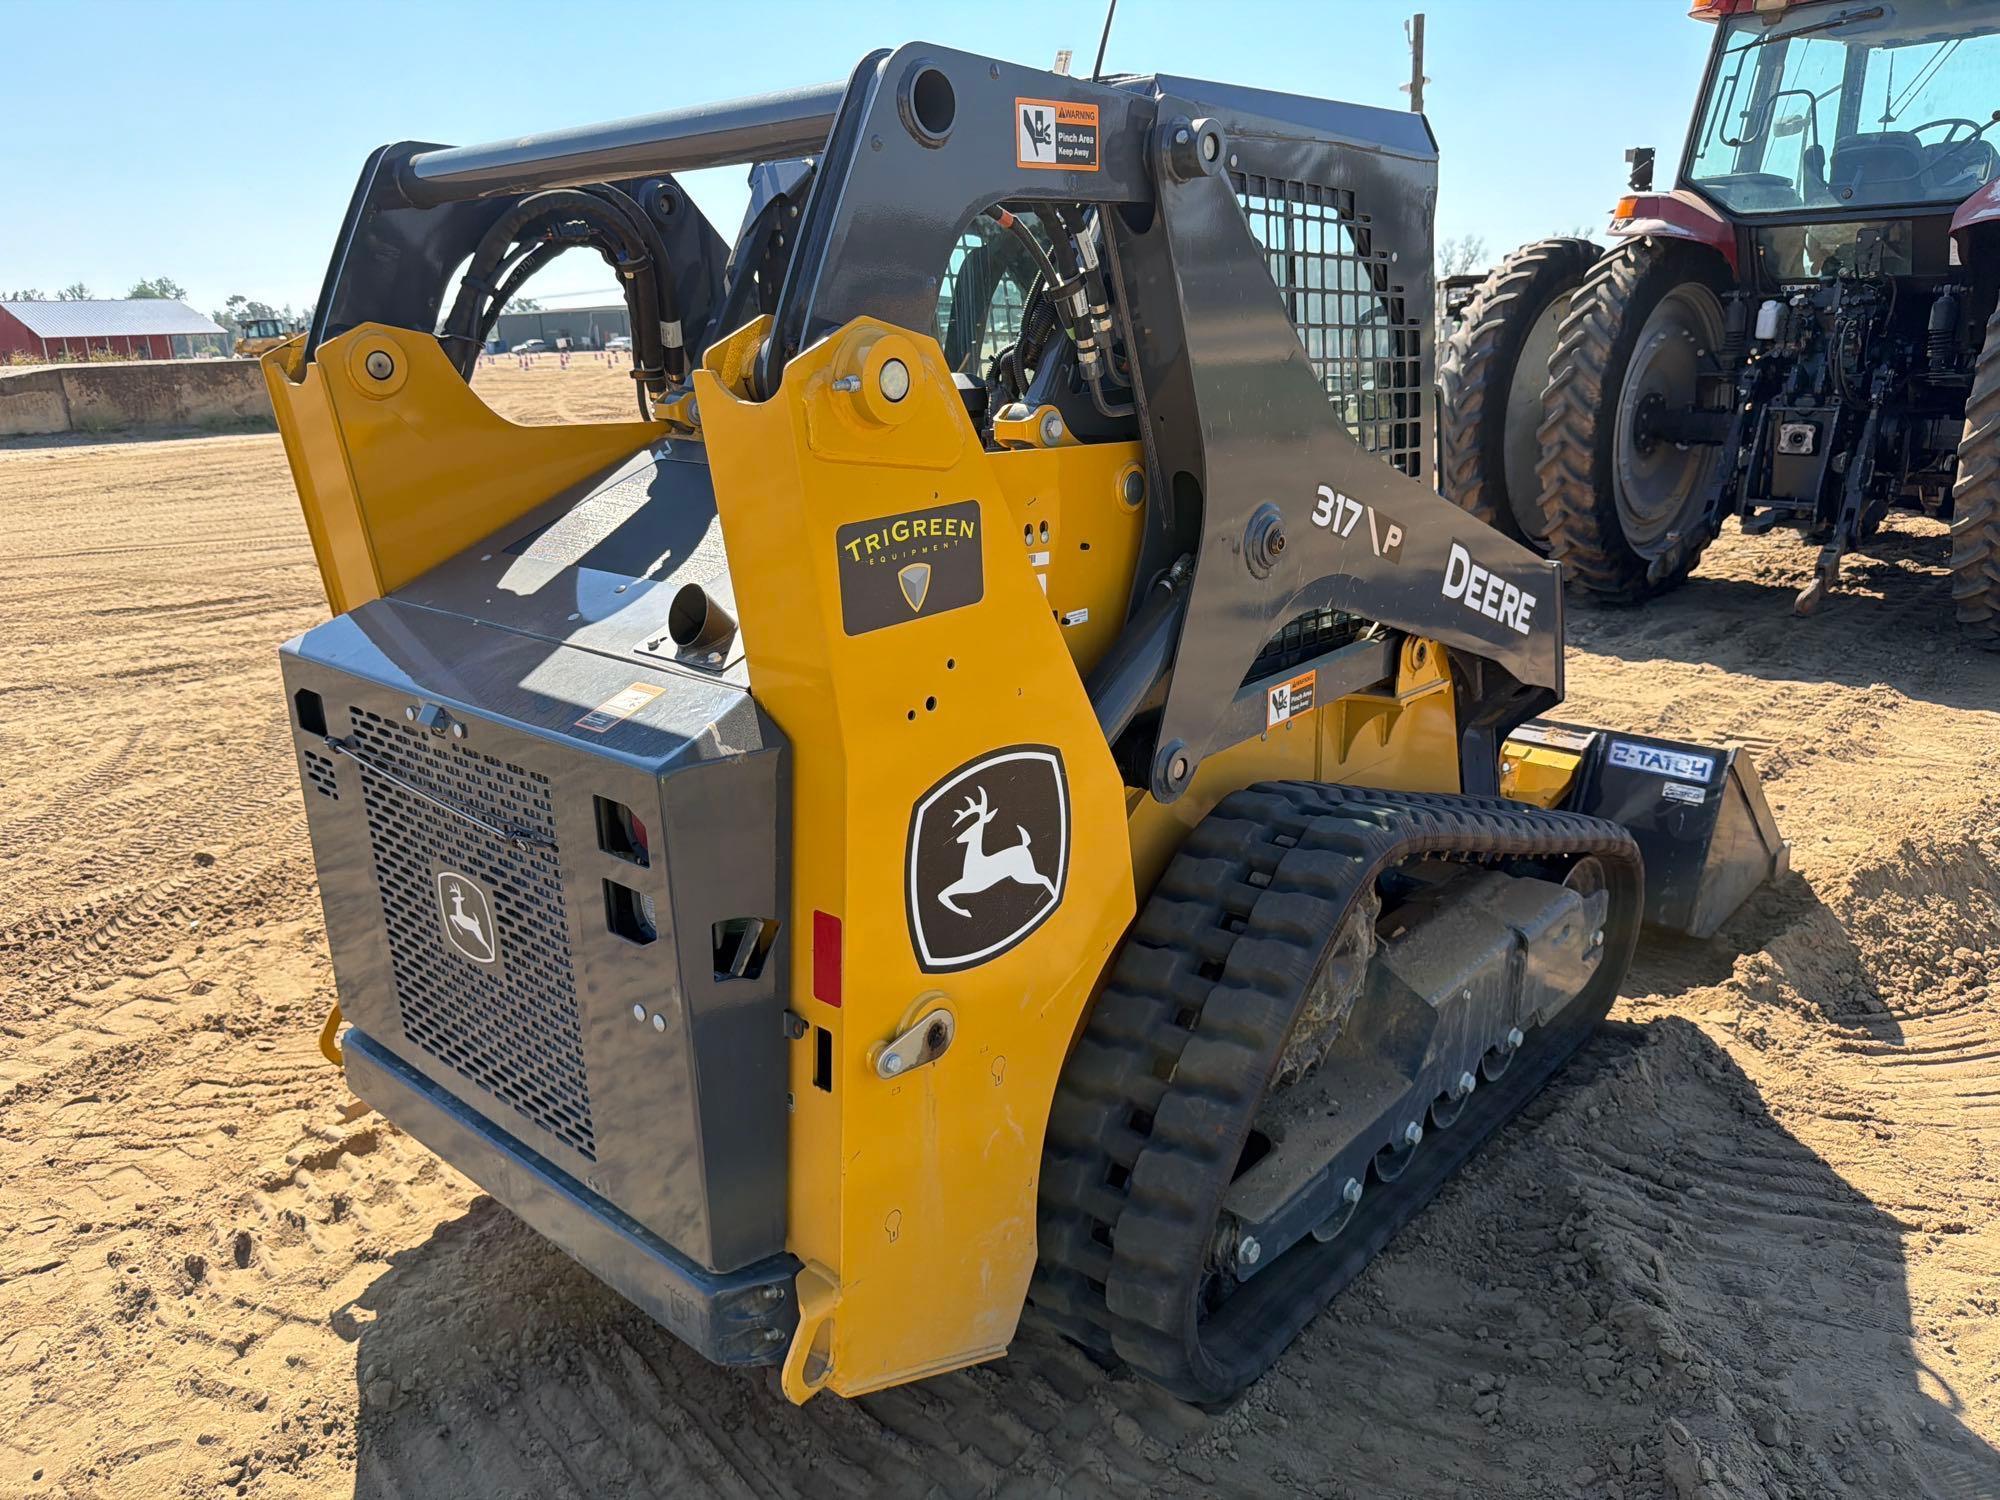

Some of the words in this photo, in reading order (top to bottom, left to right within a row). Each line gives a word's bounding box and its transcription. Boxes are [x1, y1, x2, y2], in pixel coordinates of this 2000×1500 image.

[1065, 109, 1095, 120] WARNING
[1058, 132, 1078, 143] Pinch
[1079, 134, 1095, 144] Area
[1058, 147, 1073, 156] Keep
[1074, 148, 1090, 158] Away
[869, 540, 959, 566] EQUIPMENT
[1442, 543, 1537, 635] DEERE
